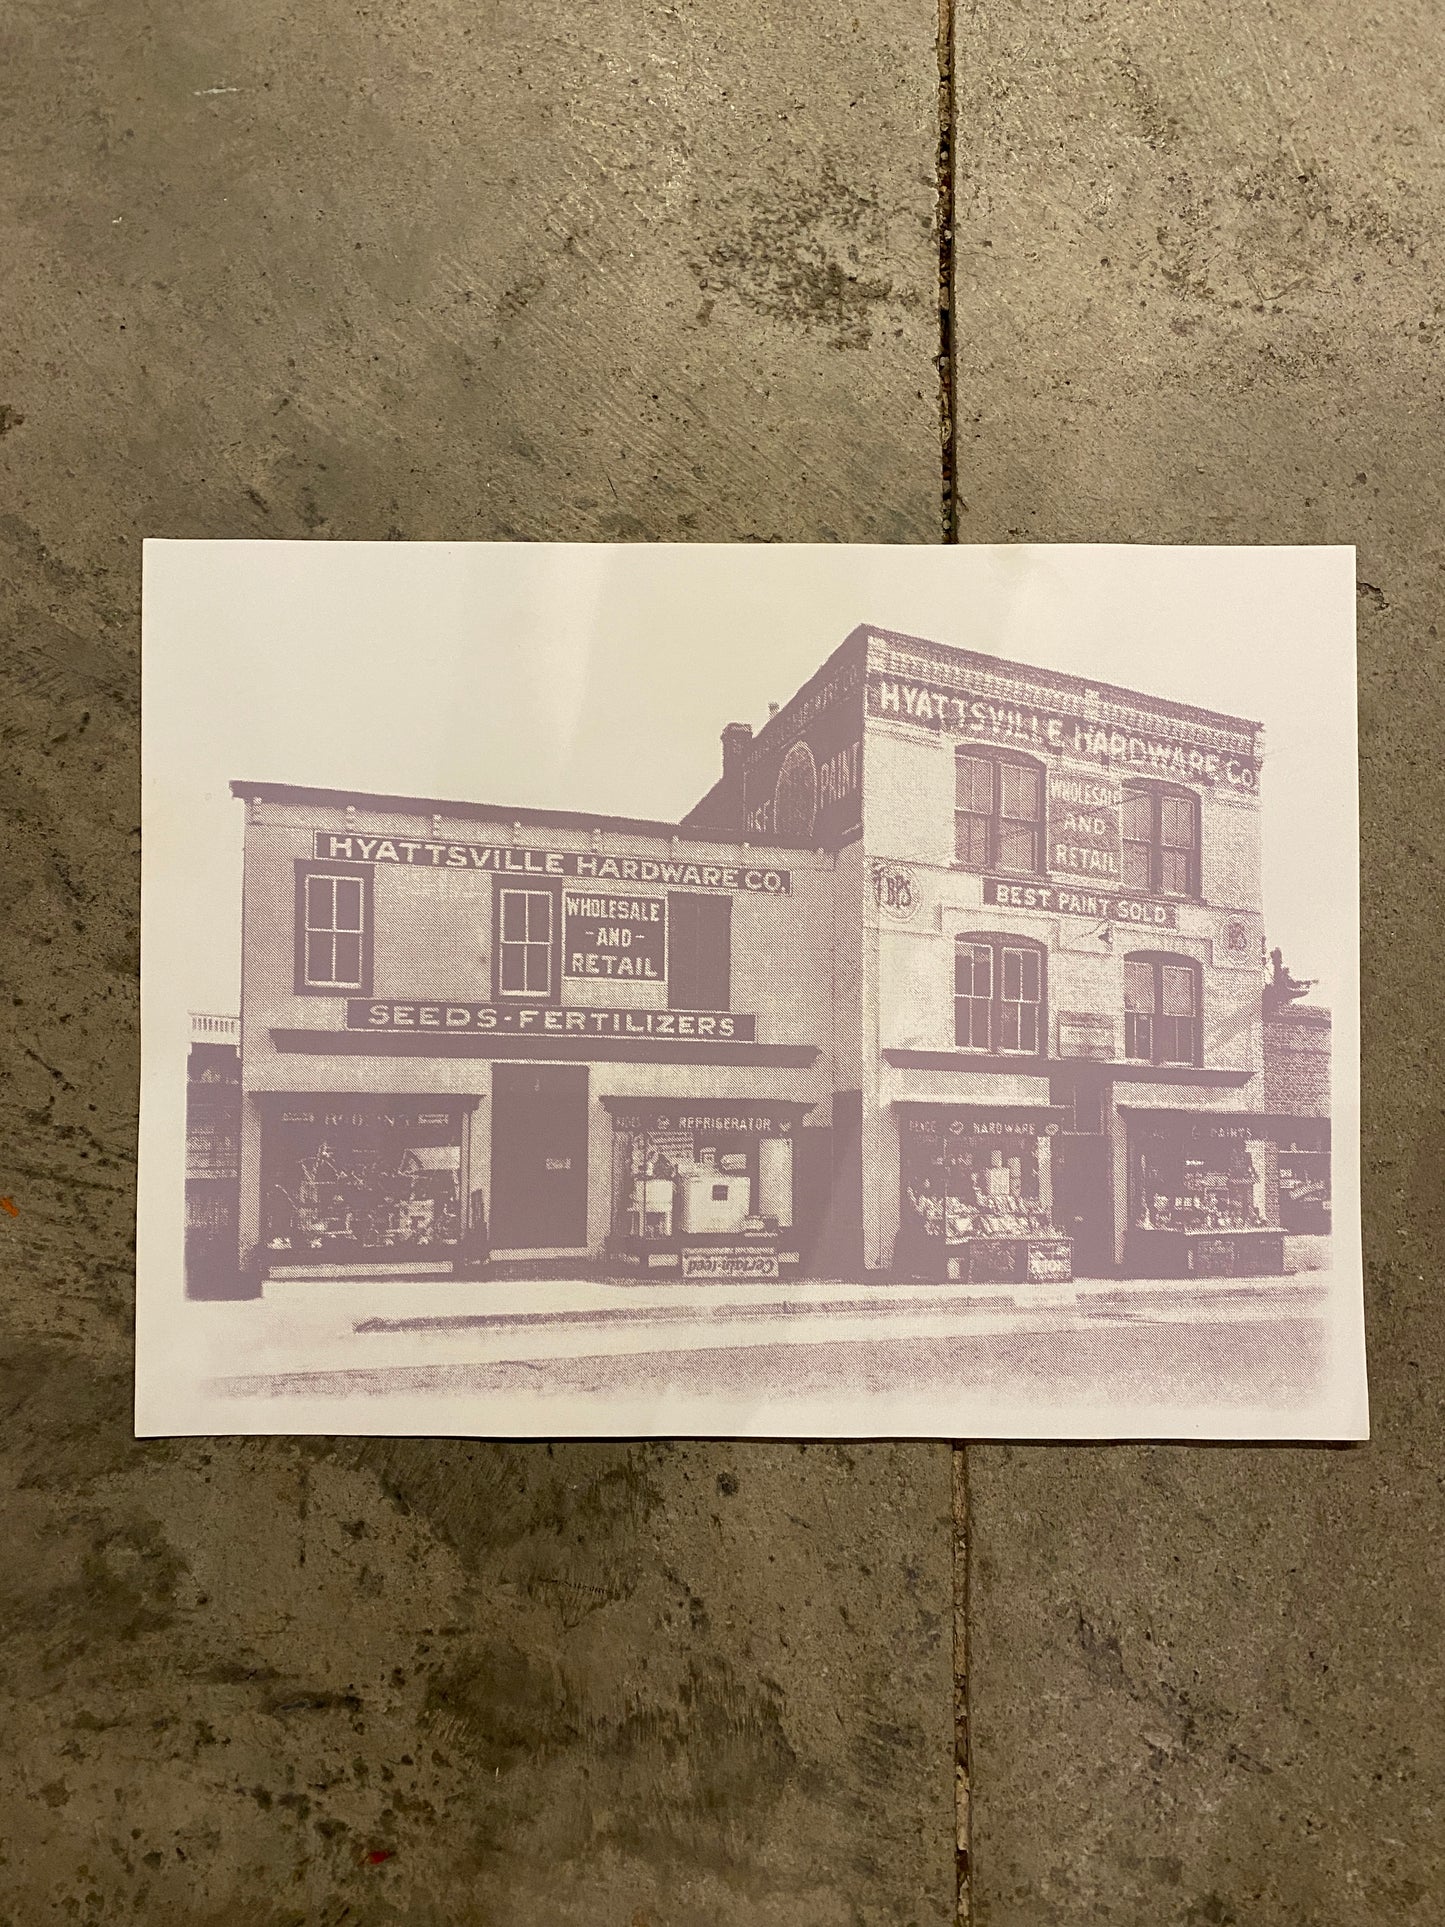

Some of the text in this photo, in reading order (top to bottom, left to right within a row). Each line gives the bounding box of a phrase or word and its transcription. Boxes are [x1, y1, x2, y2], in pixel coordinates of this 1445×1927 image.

[880, 681, 1065, 748] HYATTSVILLE
[1064, 812, 1107, 835] AND
[329, 836, 787, 893] HYATTSVILLE HARDWARE CO.
[1056, 844, 1118, 873] RETAIL
[566, 896, 660, 922] WHOLESALE
[995, 884, 1166, 923] BEST PAINT SOLD
[571, 953, 658, 977] RETAIL
[678, 1116, 772, 1131] REFRIGERATOR
[973, 1121, 1036, 1136] HARDWARE
